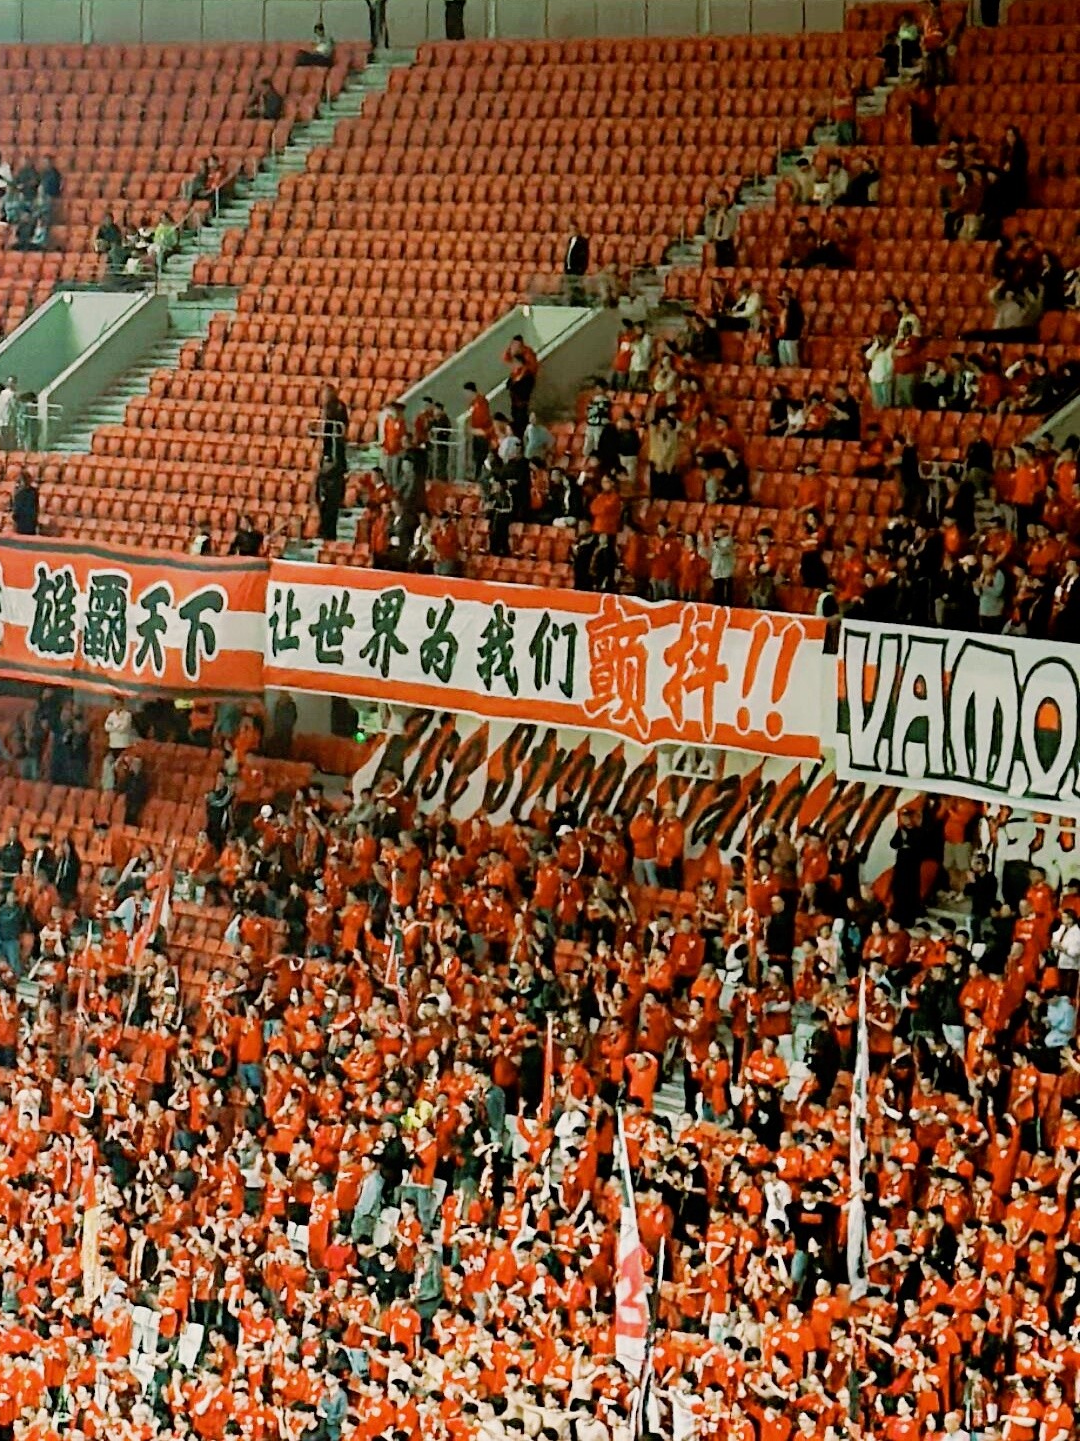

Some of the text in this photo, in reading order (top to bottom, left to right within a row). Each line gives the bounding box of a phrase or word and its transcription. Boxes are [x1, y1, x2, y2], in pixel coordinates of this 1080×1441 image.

[31, 564, 225, 679] 雄霸天下
[844, 627, 1080, 801] VAMO
